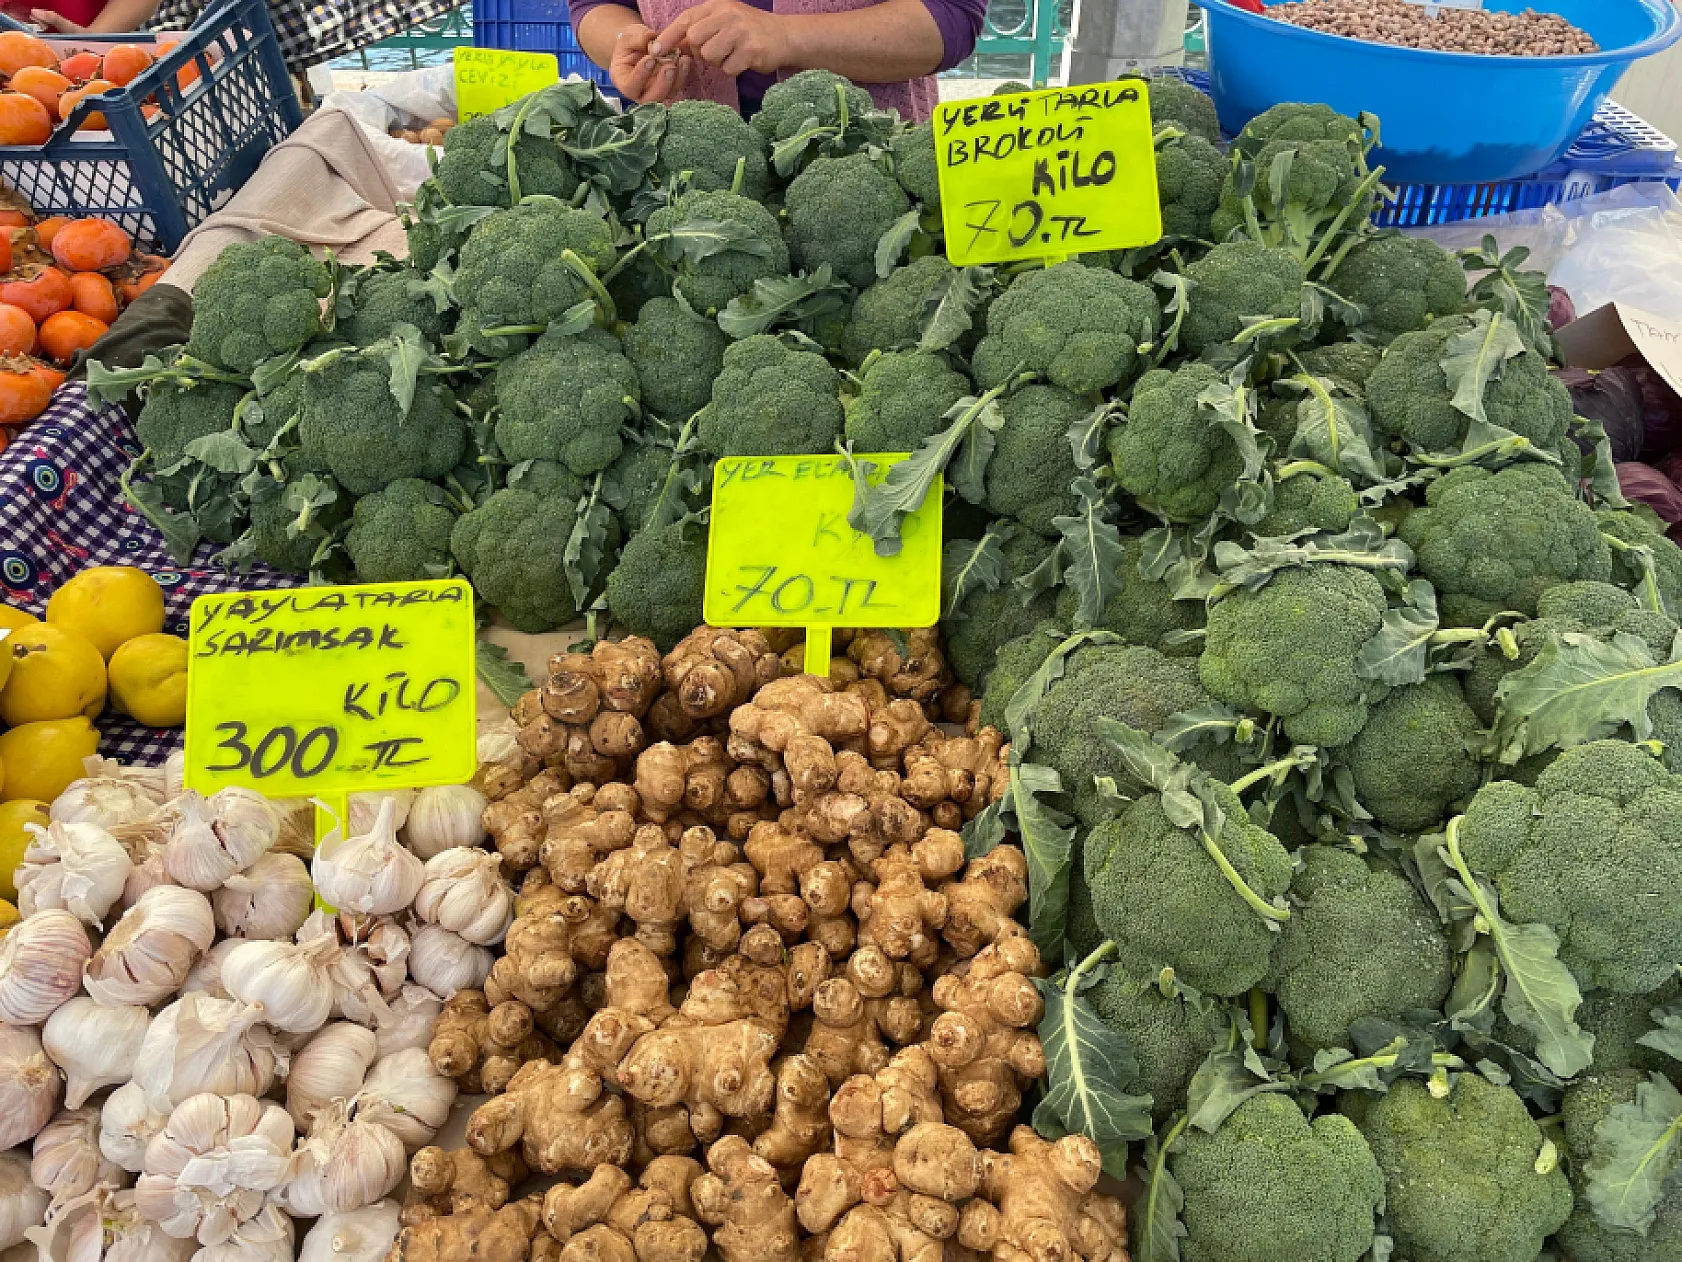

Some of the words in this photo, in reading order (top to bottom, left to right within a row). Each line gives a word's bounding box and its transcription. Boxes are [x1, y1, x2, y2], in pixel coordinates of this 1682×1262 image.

[1037, 87, 1140, 117] TARLA
[719, 459, 787, 489] YER
[195, 589, 350, 634] YAYLA
[352, 586, 464, 610] TARLA
[194, 622, 410, 659] SARIMSAK
[205, 720, 339, 779] 300
